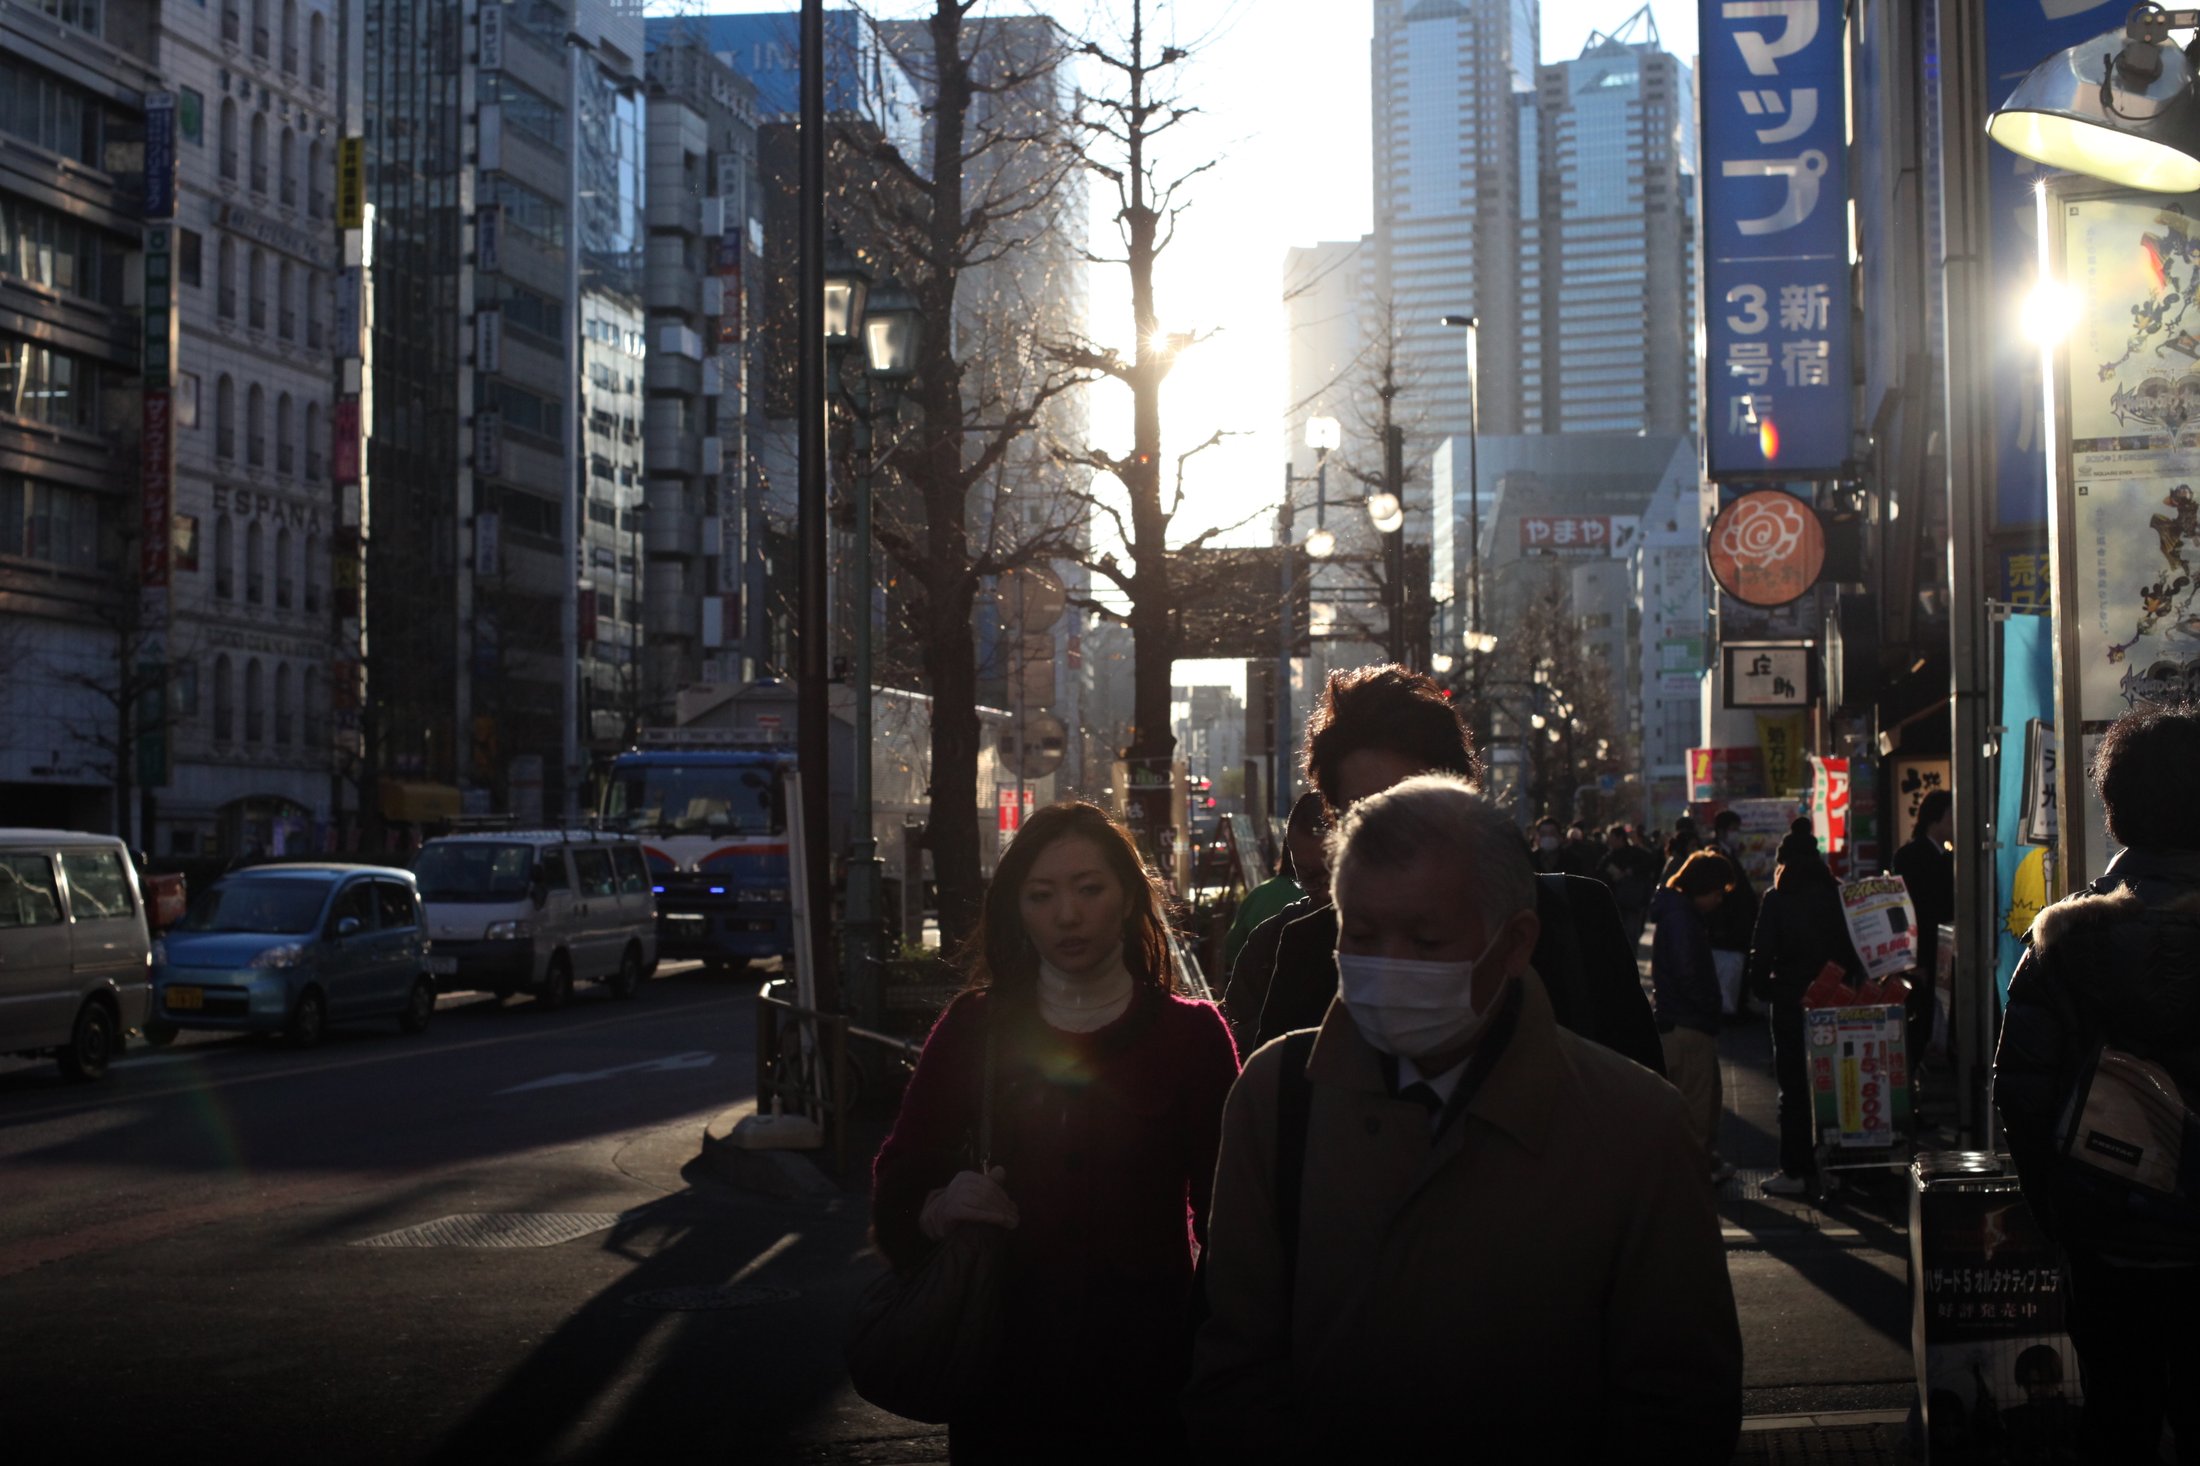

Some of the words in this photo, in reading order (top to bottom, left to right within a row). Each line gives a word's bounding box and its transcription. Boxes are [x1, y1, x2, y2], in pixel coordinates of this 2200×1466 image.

[1780, 284, 1831, 388] 新宿
[1525, 519, 1606, 545] やまや
[1924, 1268, 1961, 1294] ハザード
[1963, 1268, 1973, 1294] 5
[1938, 1302, 2039, 1319] 好評発売中
